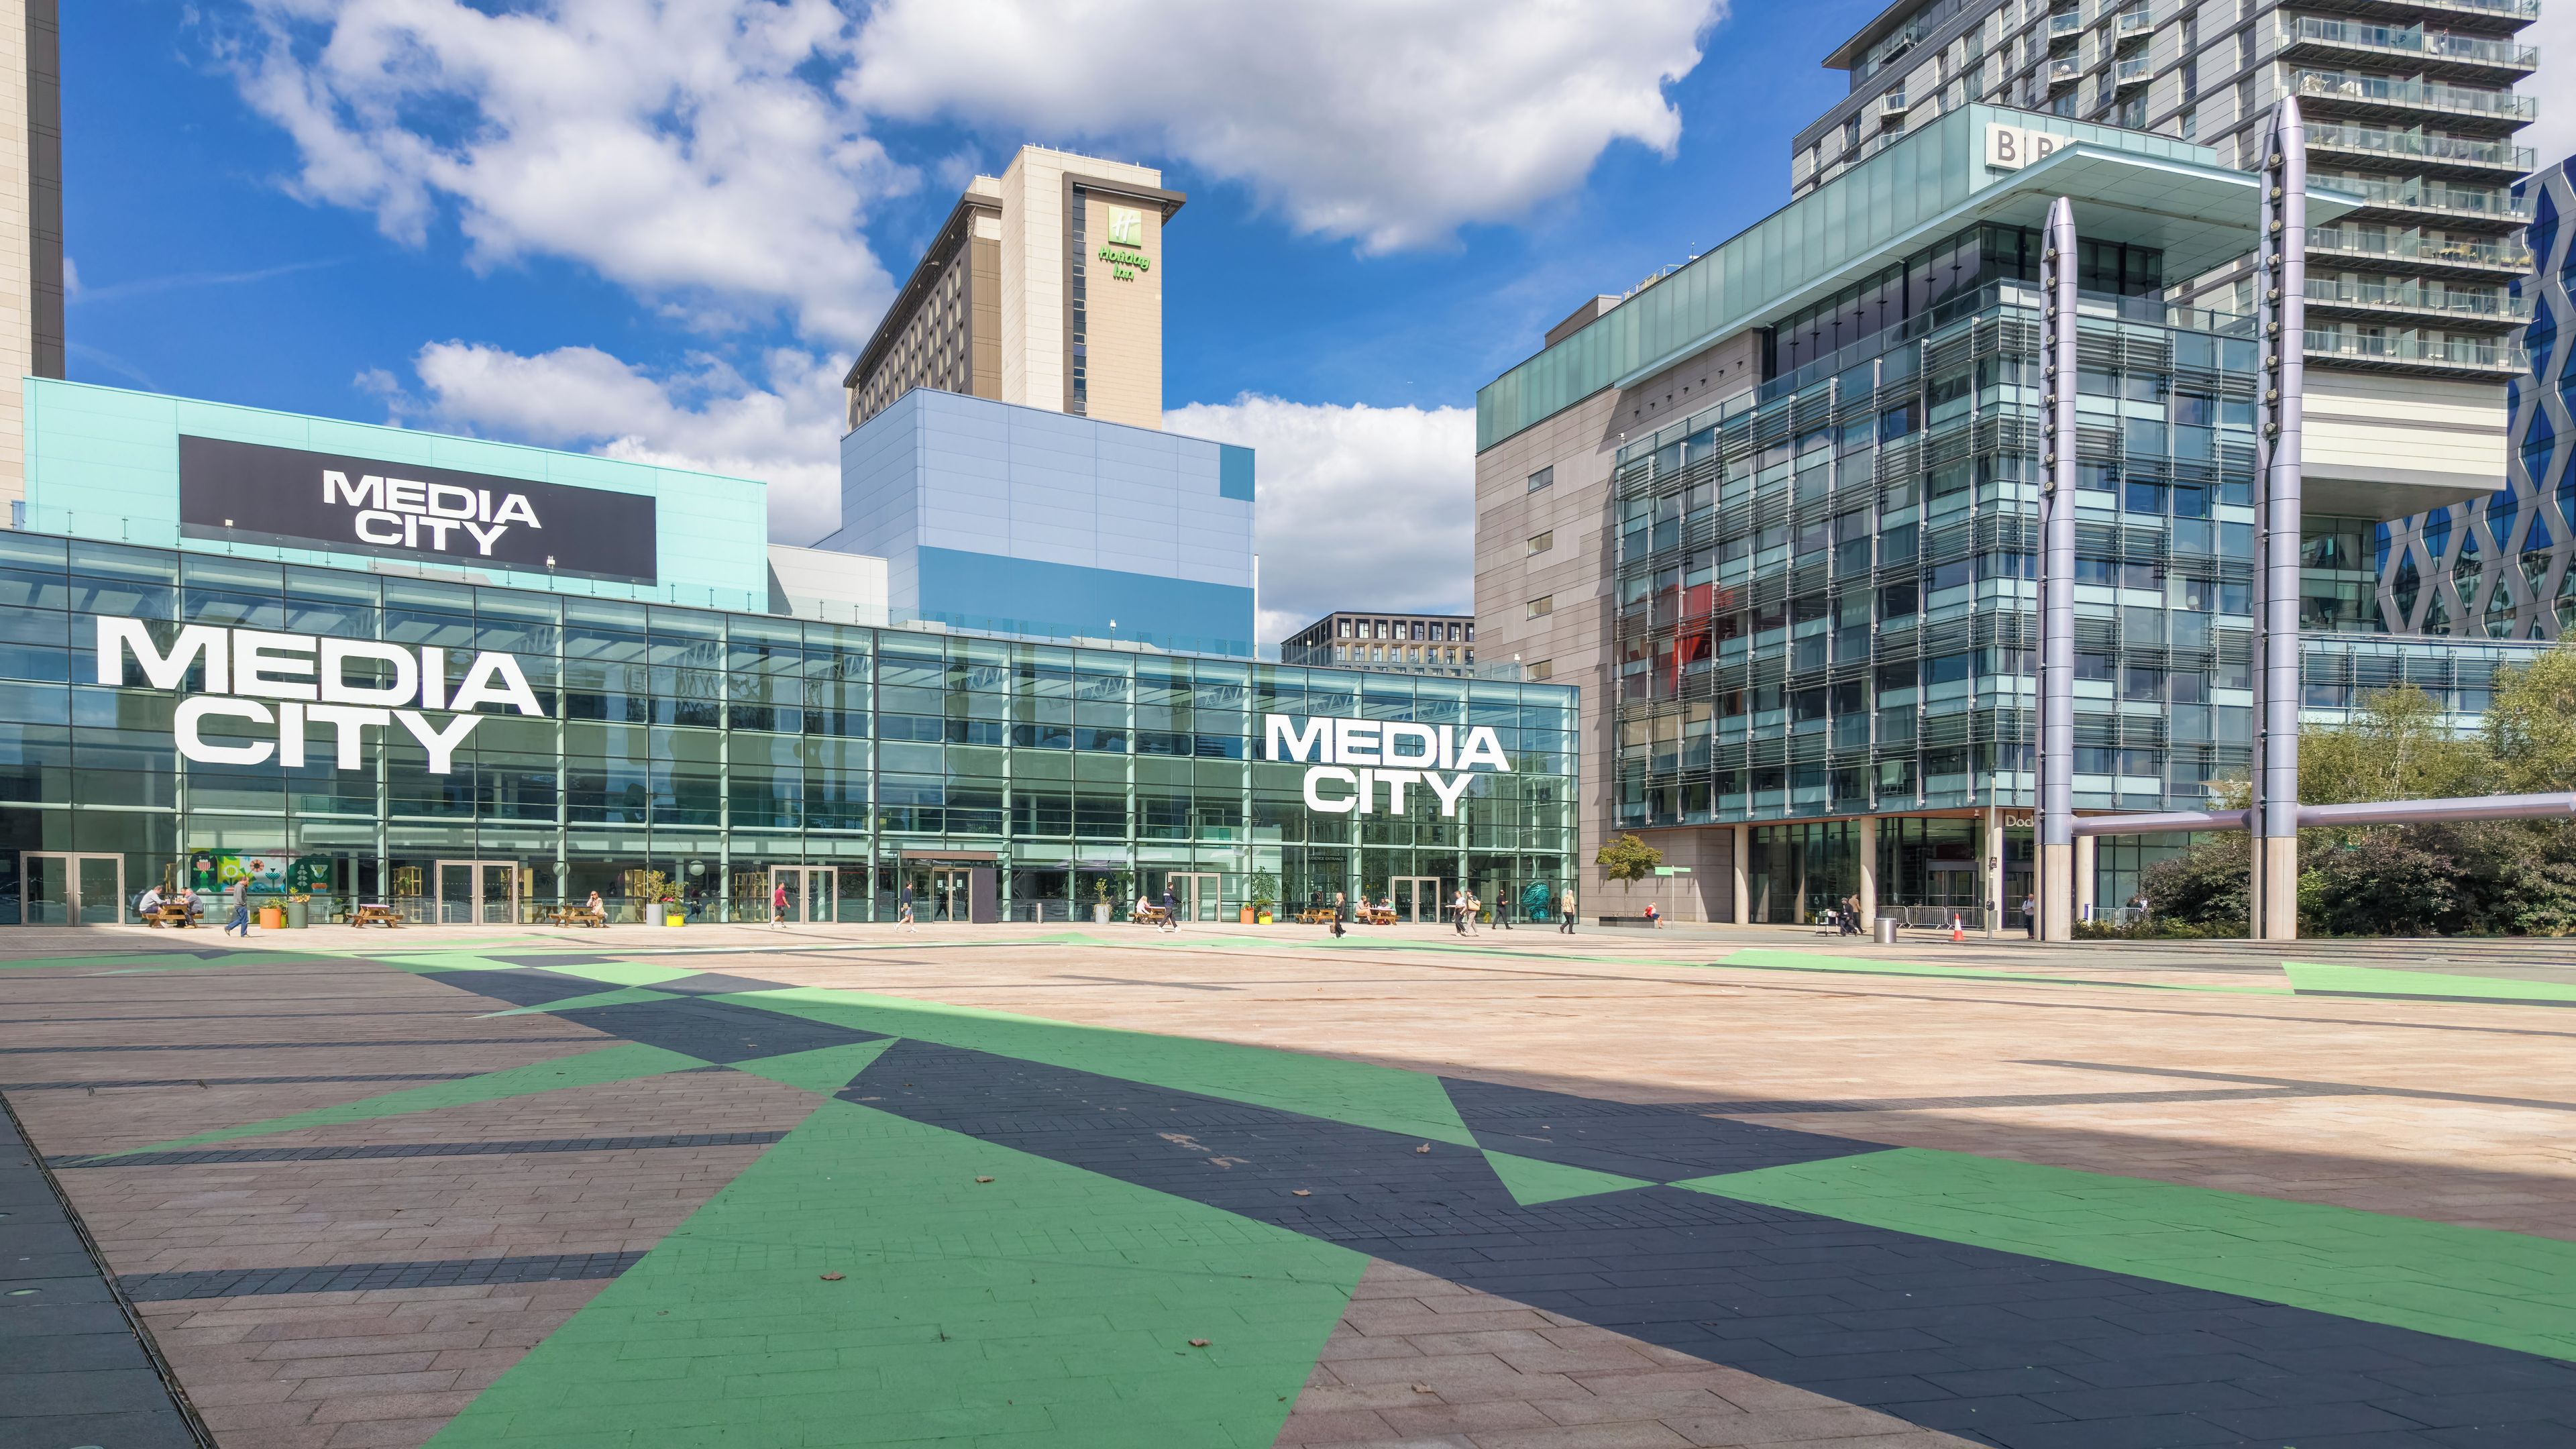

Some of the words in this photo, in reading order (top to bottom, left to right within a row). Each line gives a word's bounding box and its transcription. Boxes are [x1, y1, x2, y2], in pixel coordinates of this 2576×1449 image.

[1998, 130, 2054, 162] BB
[1099, 246, 1150, 270] Holiday
[1113, 262, 1134, 280] Inn
[323, 470, 542, 529] MEDIA
[355, 509, 508, 556] CITY
[97, 615, 545, 716] MEDIA
[174, 696, 484, 774] CITY
[1265, 714, 1511, 771] MEDIA
[1303, 765, 1475, 817] CITY
